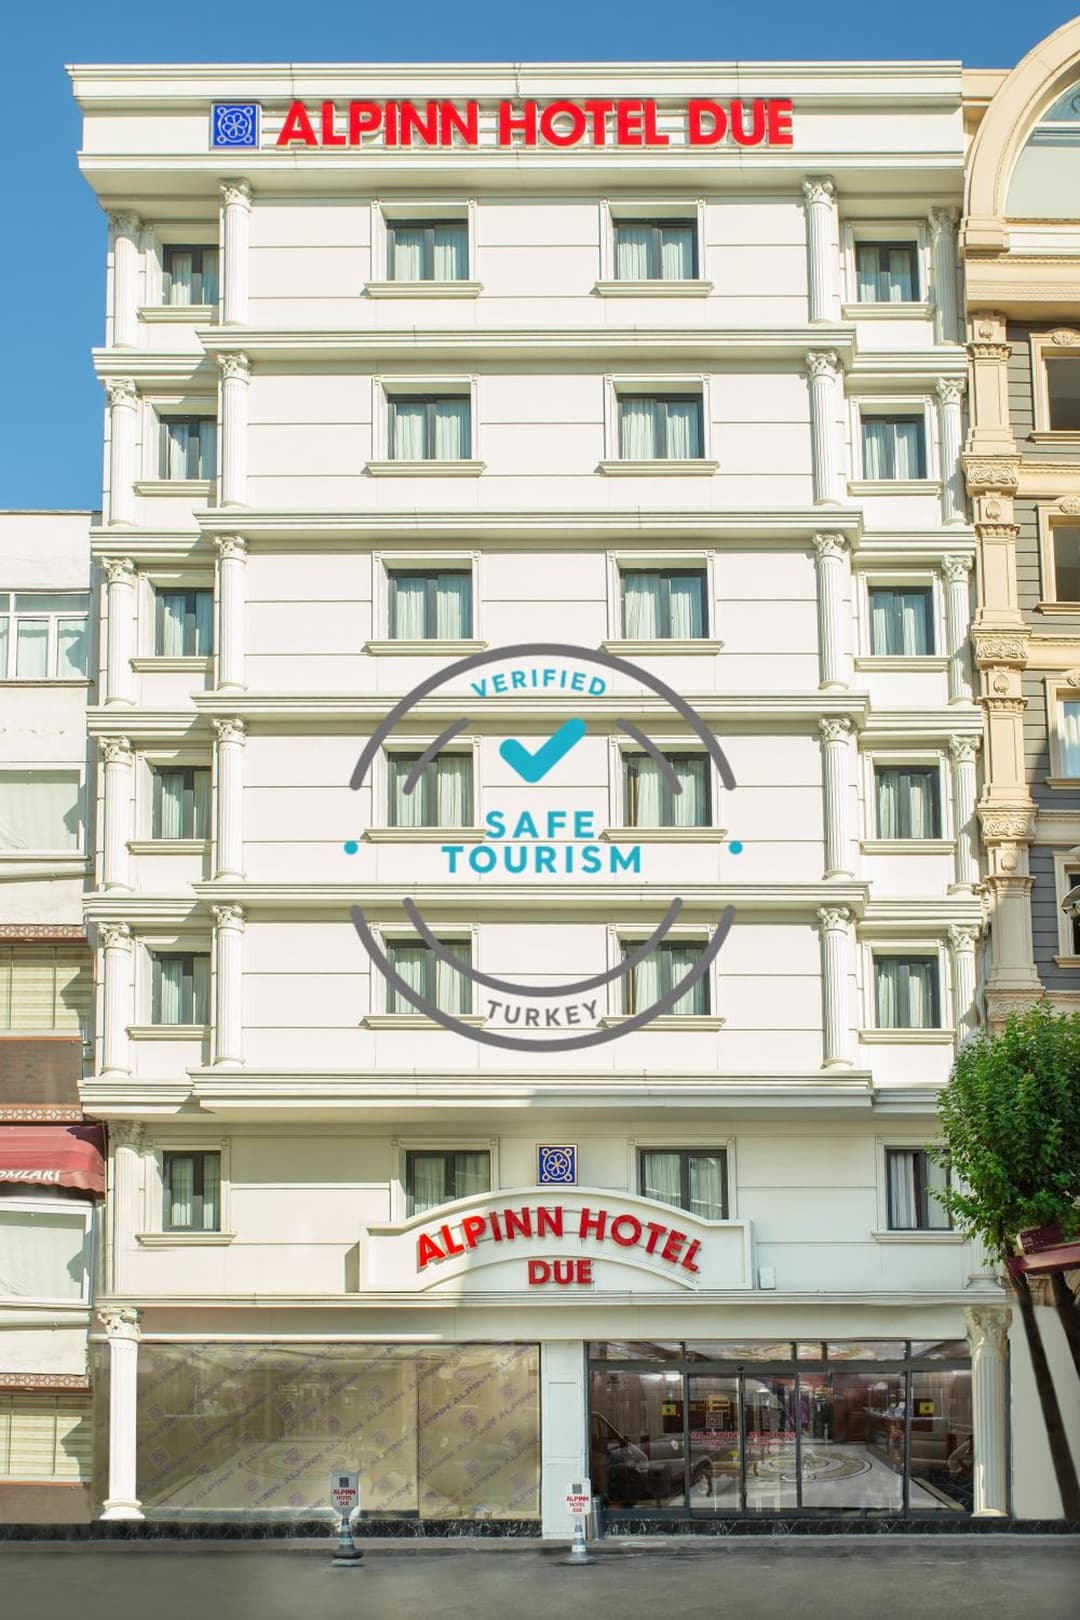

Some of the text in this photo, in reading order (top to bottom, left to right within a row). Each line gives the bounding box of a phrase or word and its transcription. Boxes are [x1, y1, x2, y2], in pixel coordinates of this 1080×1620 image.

[277, 99, 793, 147] ALPINN HOTEL DUE
[417, 1205, 702, 1273] ALPINN HOTEL
[527, 1259, 595, 1286] DUE
